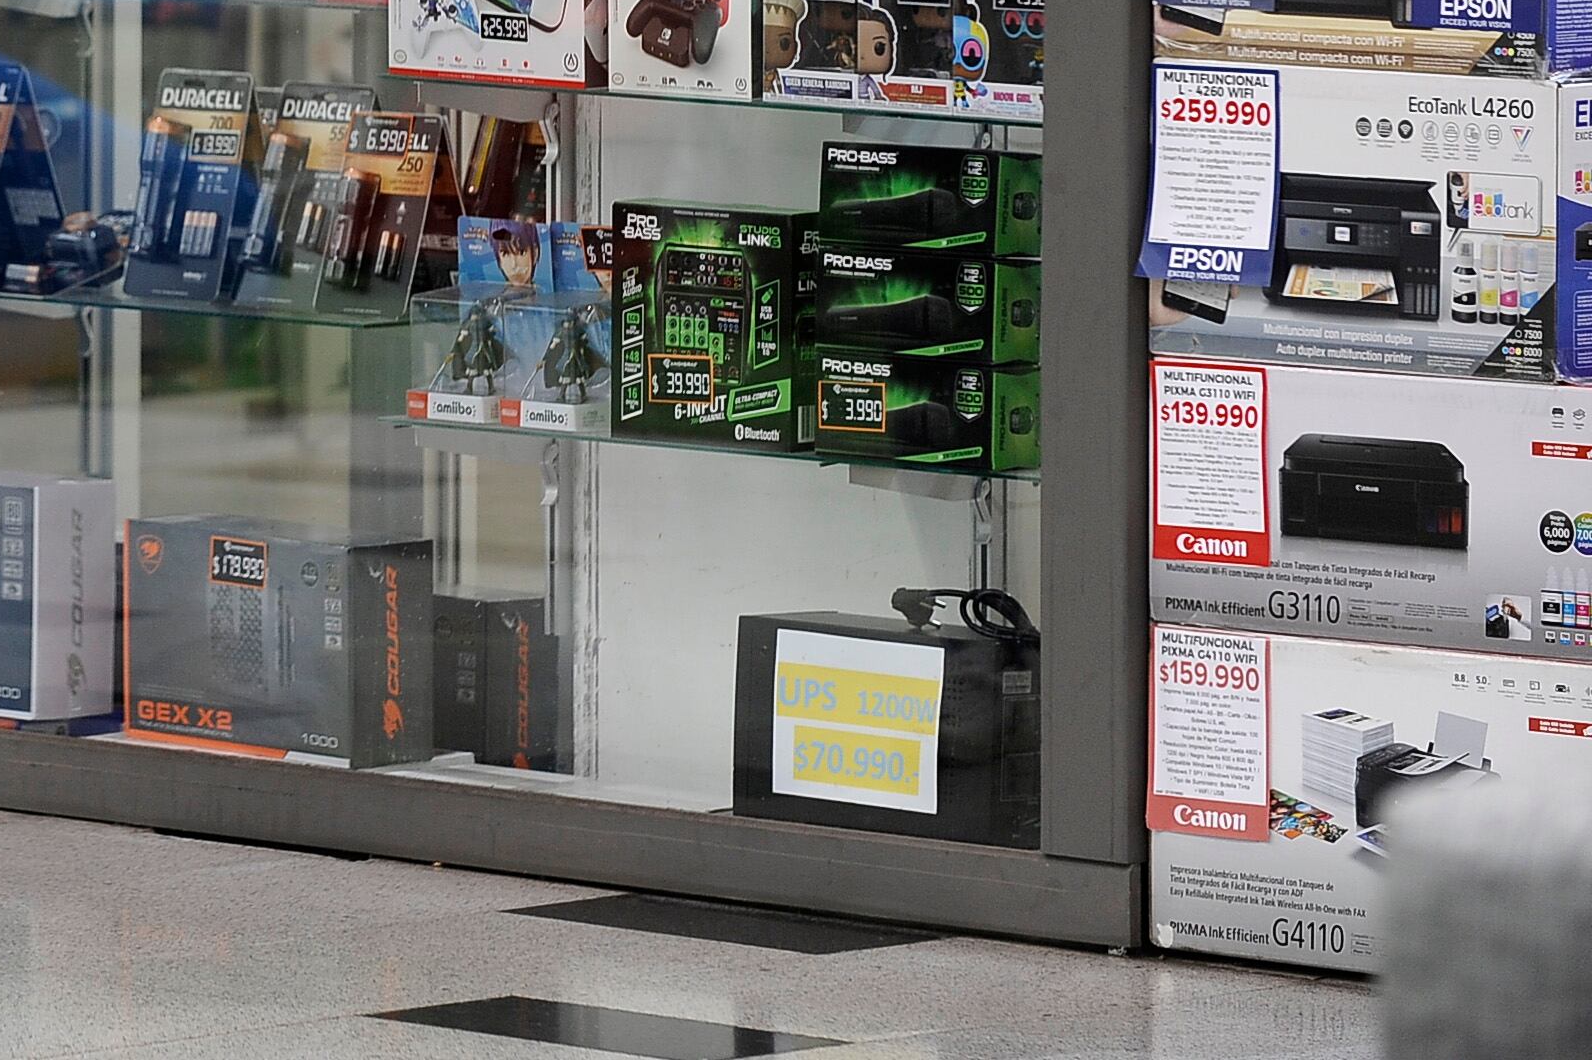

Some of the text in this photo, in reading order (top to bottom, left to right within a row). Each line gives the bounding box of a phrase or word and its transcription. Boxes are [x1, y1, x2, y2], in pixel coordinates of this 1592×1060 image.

[483, 18, 526, 39] $25.990
[1230, 27, 1300, 42] Multifuncional
[1303, 33, 1353, 46] compacta
[1227, 46, 1297, 61] Multifuncional
[1299, 52, 1349, 65] compacta
[1163, 71, 1270, 88] MULTIFUNCIONAL
[162, 87, 243, 110] DURACELL
[1408, 96, 1535, 119] EcoTank L4260
[1161, 98, 1271, 127] $259.990
[210, 116, 233, 130] 700
[398, 156, 423, 173] 250
[962, 178, 987, 190] 500
[627, 213, 658, 228] PRO
[739, 224, 780, 237] STUDIO
[1168, 246, 1244, 273] EPSON
[959, 285, 983, 297] 500
[1263, 322, 1323, 339] Multifuncional
[1384, 333, 1414, 347] duplex
[1276, 342, 1413, 365] Auto duplex multifunction printer
[1523, 346, 1543, 358] 6000
[1163, 371, 1254, 386] MULTIFUNCIONAL
[957, 393, 982, 404] 500
[1164, 385, 1256, 401] PIXMA G3110 WIFI
[436, 401, 473, 416] amiibo
[529, 409, 567, 425] amiibo
[1160, 400, 1258, 428] $139.990
[744, 426, 780, 441] Bluetooth
[1355, 483, 1380, 494] Canon
[1544, 526, 1571, 539] 6,000
[1176, 533, 1248, 558] Canon
[1294, 560, 1321, 575] Tanques
[1322, 563, 1331, 573] de
[1331, 564, 1348, 575] Tinta
[1349, 565, 1383, 579] Integrados
[1384, 568, 1393, 578] de
[1409, 571, 1436, 583] Recarga
[1165, 596, 1202, 612] PIXMA
[1204, 600, 1221, 614] Ink
[1222, 601, 1266, 619] Efficient
[1268, 590, 1341, 625] G3110
[386, 565, 403, 696] COUGAR
[1162, 632, 1255, 651] MULTIFUNCIONAL
[1161, 645, 1258, 665] PIXMA G4110 WIFI
[1160, 660, 1260, 691] $159.990
[779, 676, 938, 724] UPS 1200W
[138, 700, 233, 731] GEX X2
[300, 733, 339, 749] 1000
[1173, 804, 1247, 832] Canon
[1170, 864, 1201, 877] Impresora
[1240, 871, 1285, 886] Multifuncional
[1285, 878, 1297, 888] con
[1298, 878, 1325, 891] Tanques
[1325, 882, 1334, 892] de
[1170, 886, 1184, 898] Easy
[1185, 888, 1214, 900] Refillable
[1215, 891, 1249, 905] Integrated
[1249, 895, 1259, 905] Ink
[1261, 897, 1276, 908] Tank
[1277, 898, 1304, 911] Wireless
[1337, 906, 1352, 917] with
[1353, 908, 1367, 919] FAX
[1170, 917, 1345, 954] PIXMA Ink Efficient G4110
